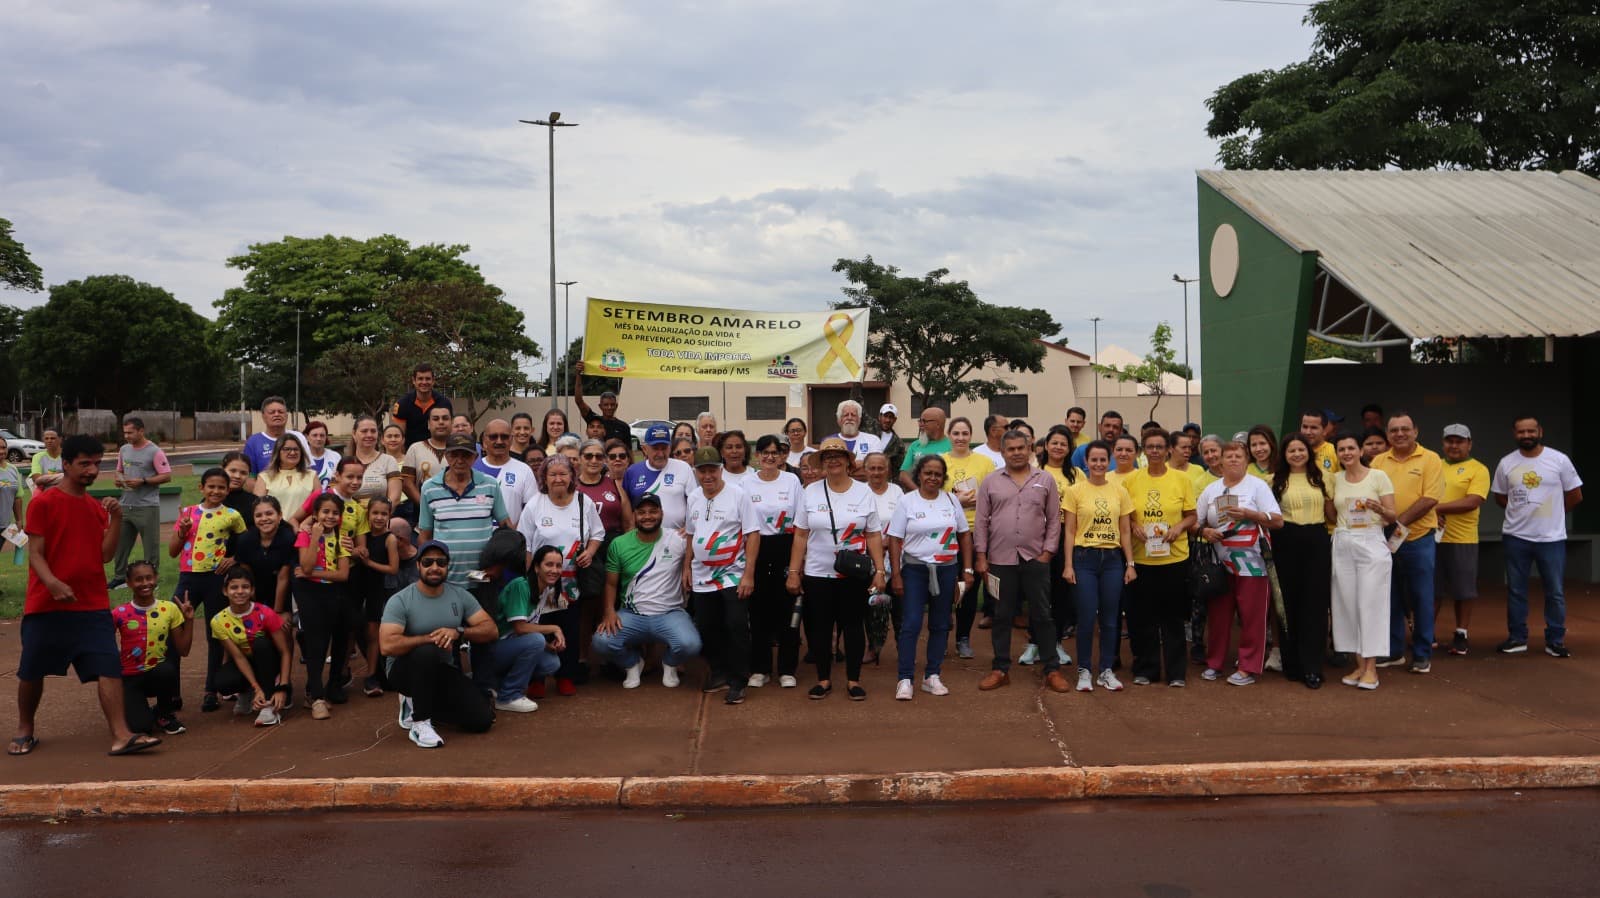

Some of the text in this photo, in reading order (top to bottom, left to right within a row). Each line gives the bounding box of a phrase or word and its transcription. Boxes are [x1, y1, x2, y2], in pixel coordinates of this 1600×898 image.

[603, 307, 801, 329] SETEMBRO AMARELO
[614, 322, 631, 330] MÊS
[633, 324, 645, 332] DA
[647, 326, 701, 336] VALORIZAÇÃO
[635, 334, 682, 344] PREVENÇÃO
[683, 338, 696, 346] AO
[697, 339, 732, 347] SUICÍDIO
[647, 347, 752, 361] TODA VIDA IMPORTA
[693, 367, 728, 375] Caarapó
[736, 367, 750, 375] MS
[1143, 509, 1163, 517] NÃO
[1093, 516, 1112, 525] NÃO
[1083, 531, 1116, 540] de você
